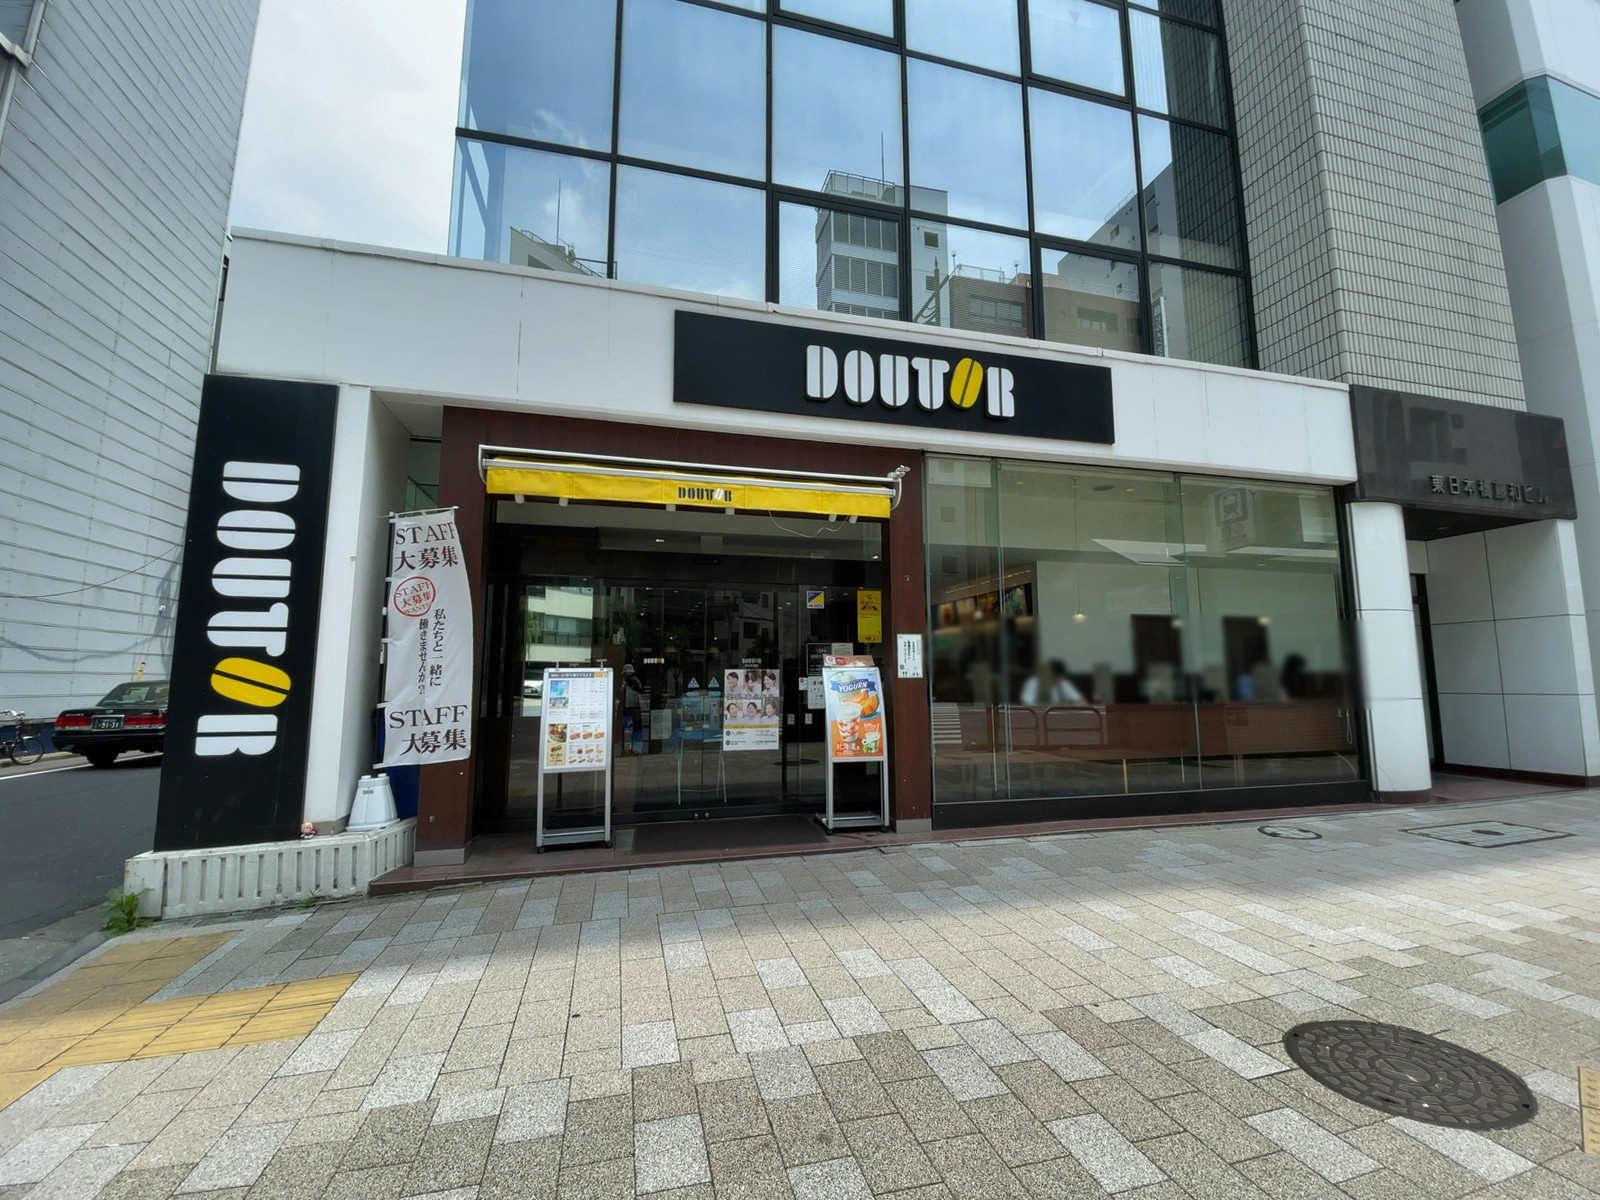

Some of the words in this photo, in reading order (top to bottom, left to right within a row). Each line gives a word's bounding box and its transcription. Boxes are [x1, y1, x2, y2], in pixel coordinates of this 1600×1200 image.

[806, 344, 1015, 419] DOUTOR
[678, 486, 733, 503] DOUTOR
[395, 521, 455, 546] STAFF
[394, 545, 459, 573] 大募集
[195, 461, 301, 757] DOUTOR
[429, 608, 447, 687] 私たちと一緒に
[389, 704, 469, 729] STAFF
[400, 728, 468, 756] 大募集
